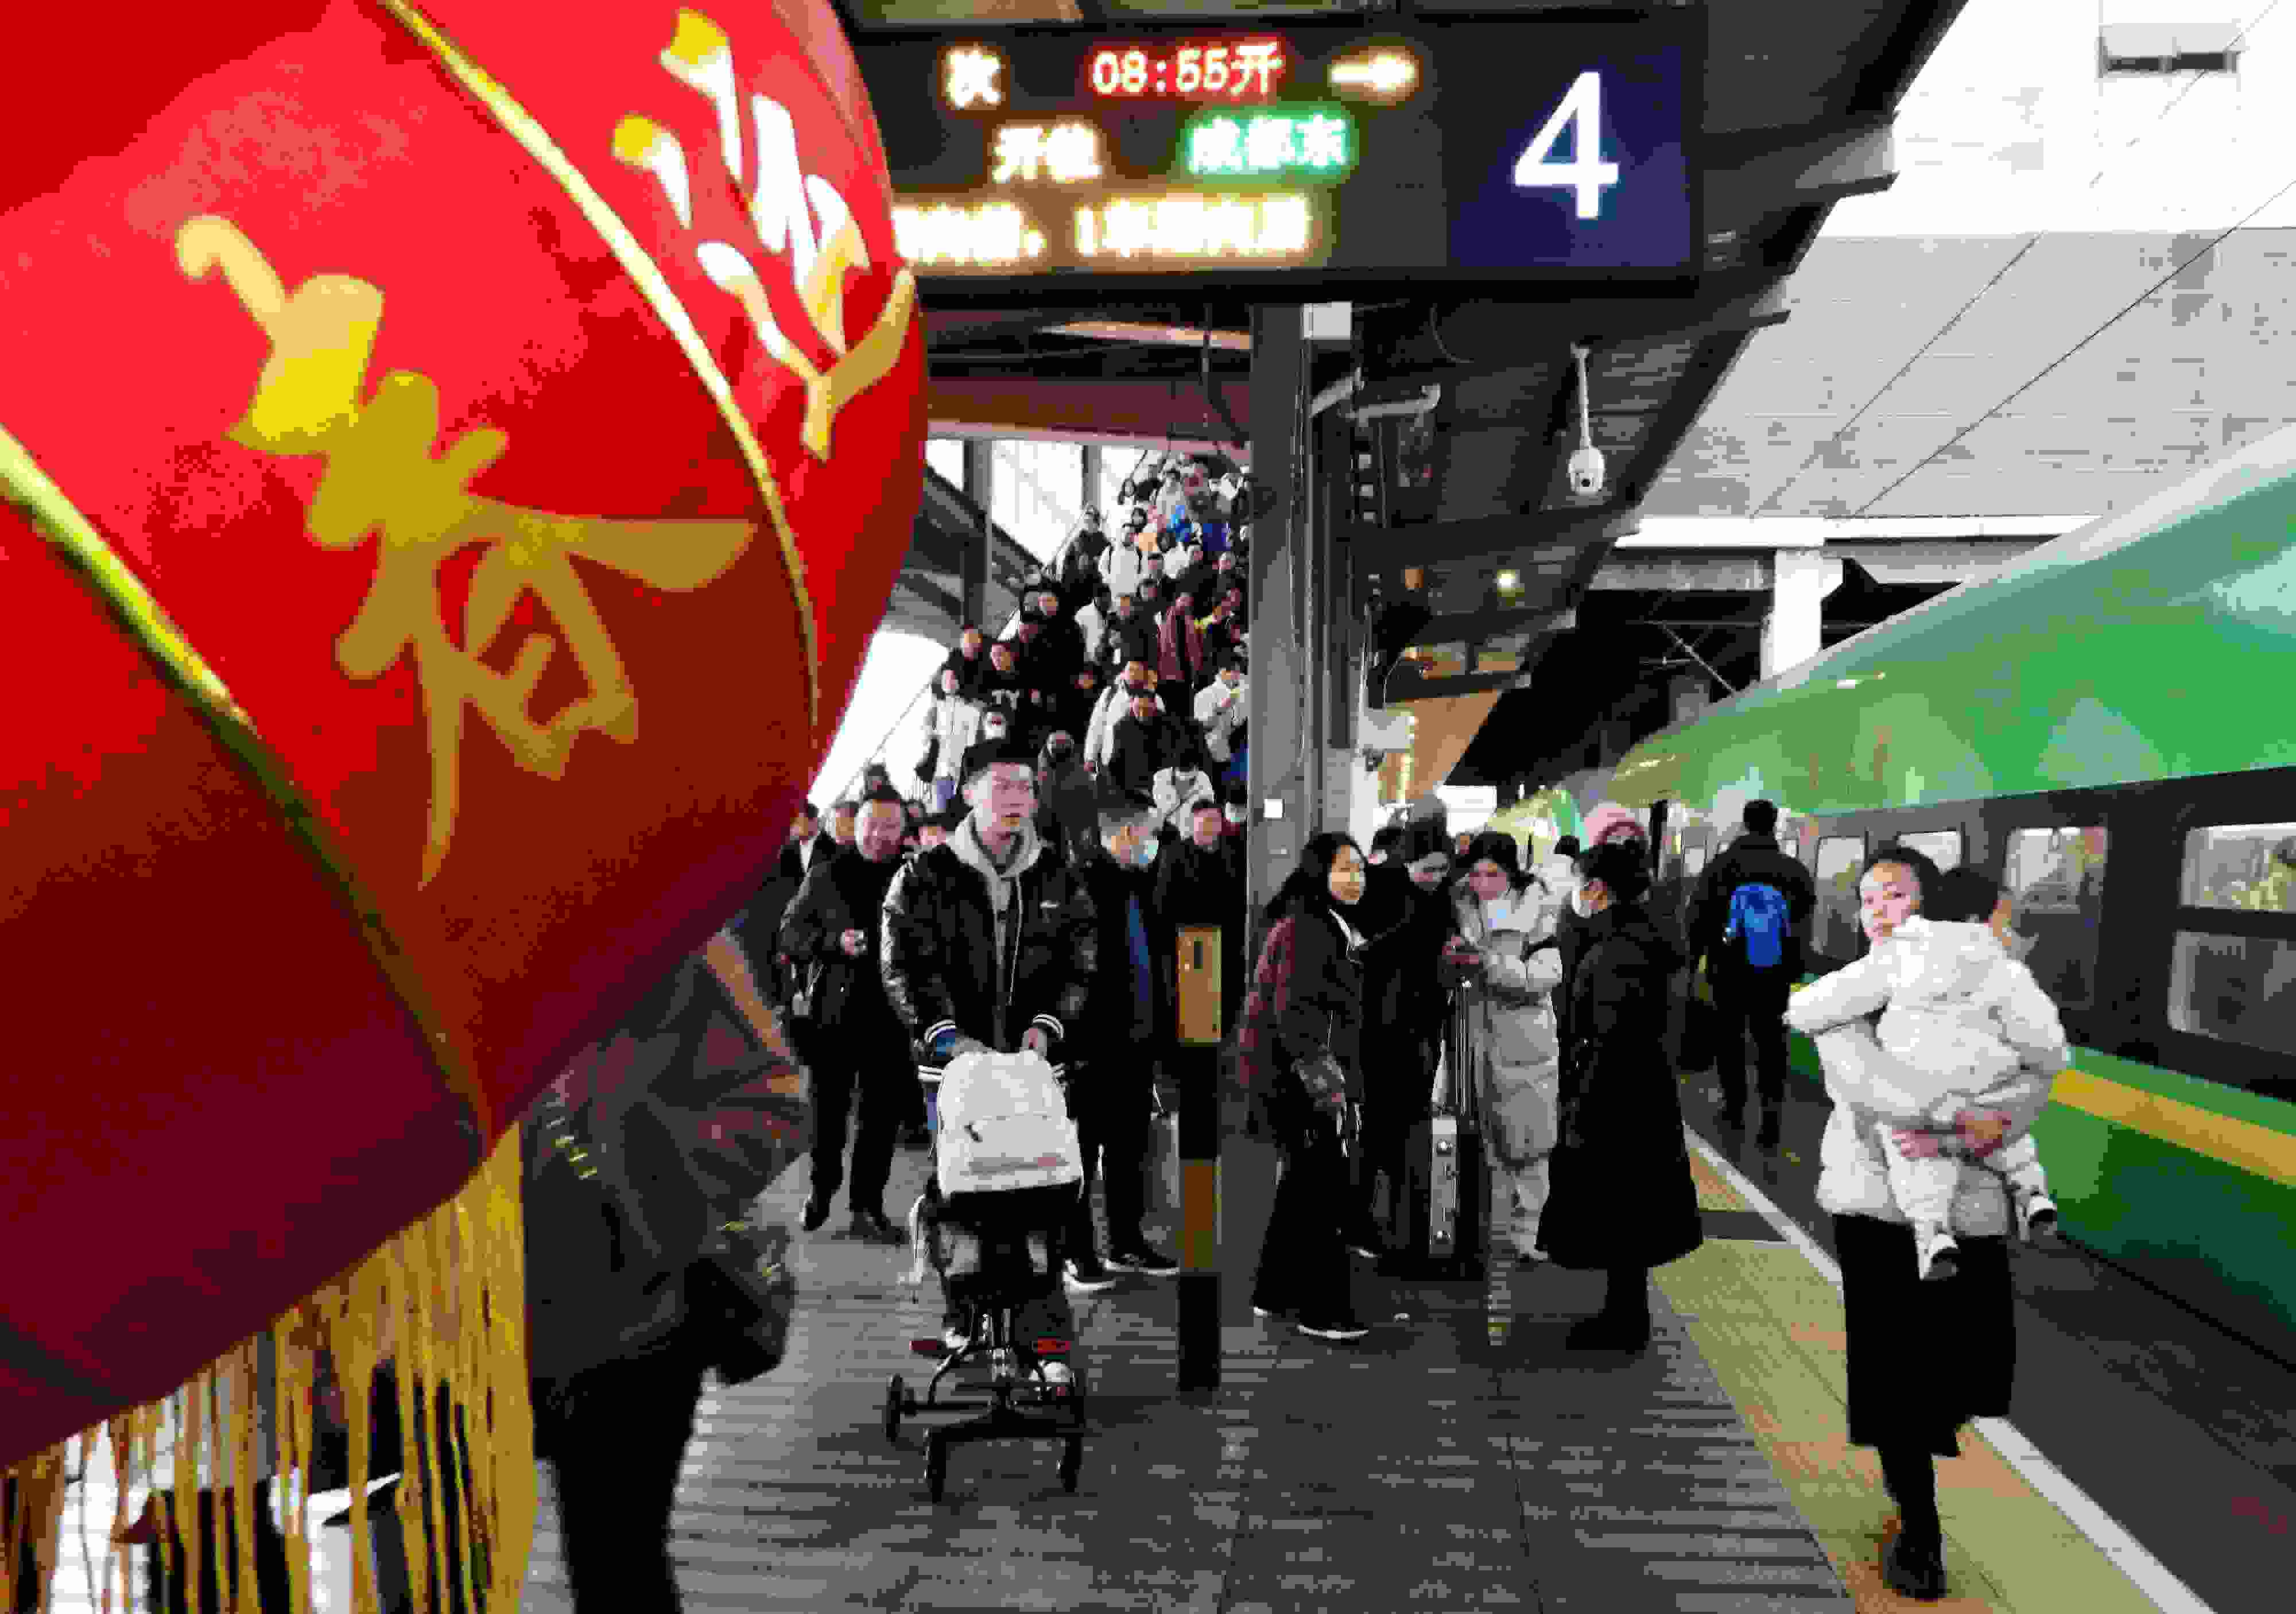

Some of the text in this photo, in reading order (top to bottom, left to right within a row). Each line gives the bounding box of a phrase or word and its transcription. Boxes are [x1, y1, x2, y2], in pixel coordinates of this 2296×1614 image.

[1093, 41, 1283, 96] 08:55开
[1515, 71, 1619, 219] 4
[174, 214, 757, 891] 春
